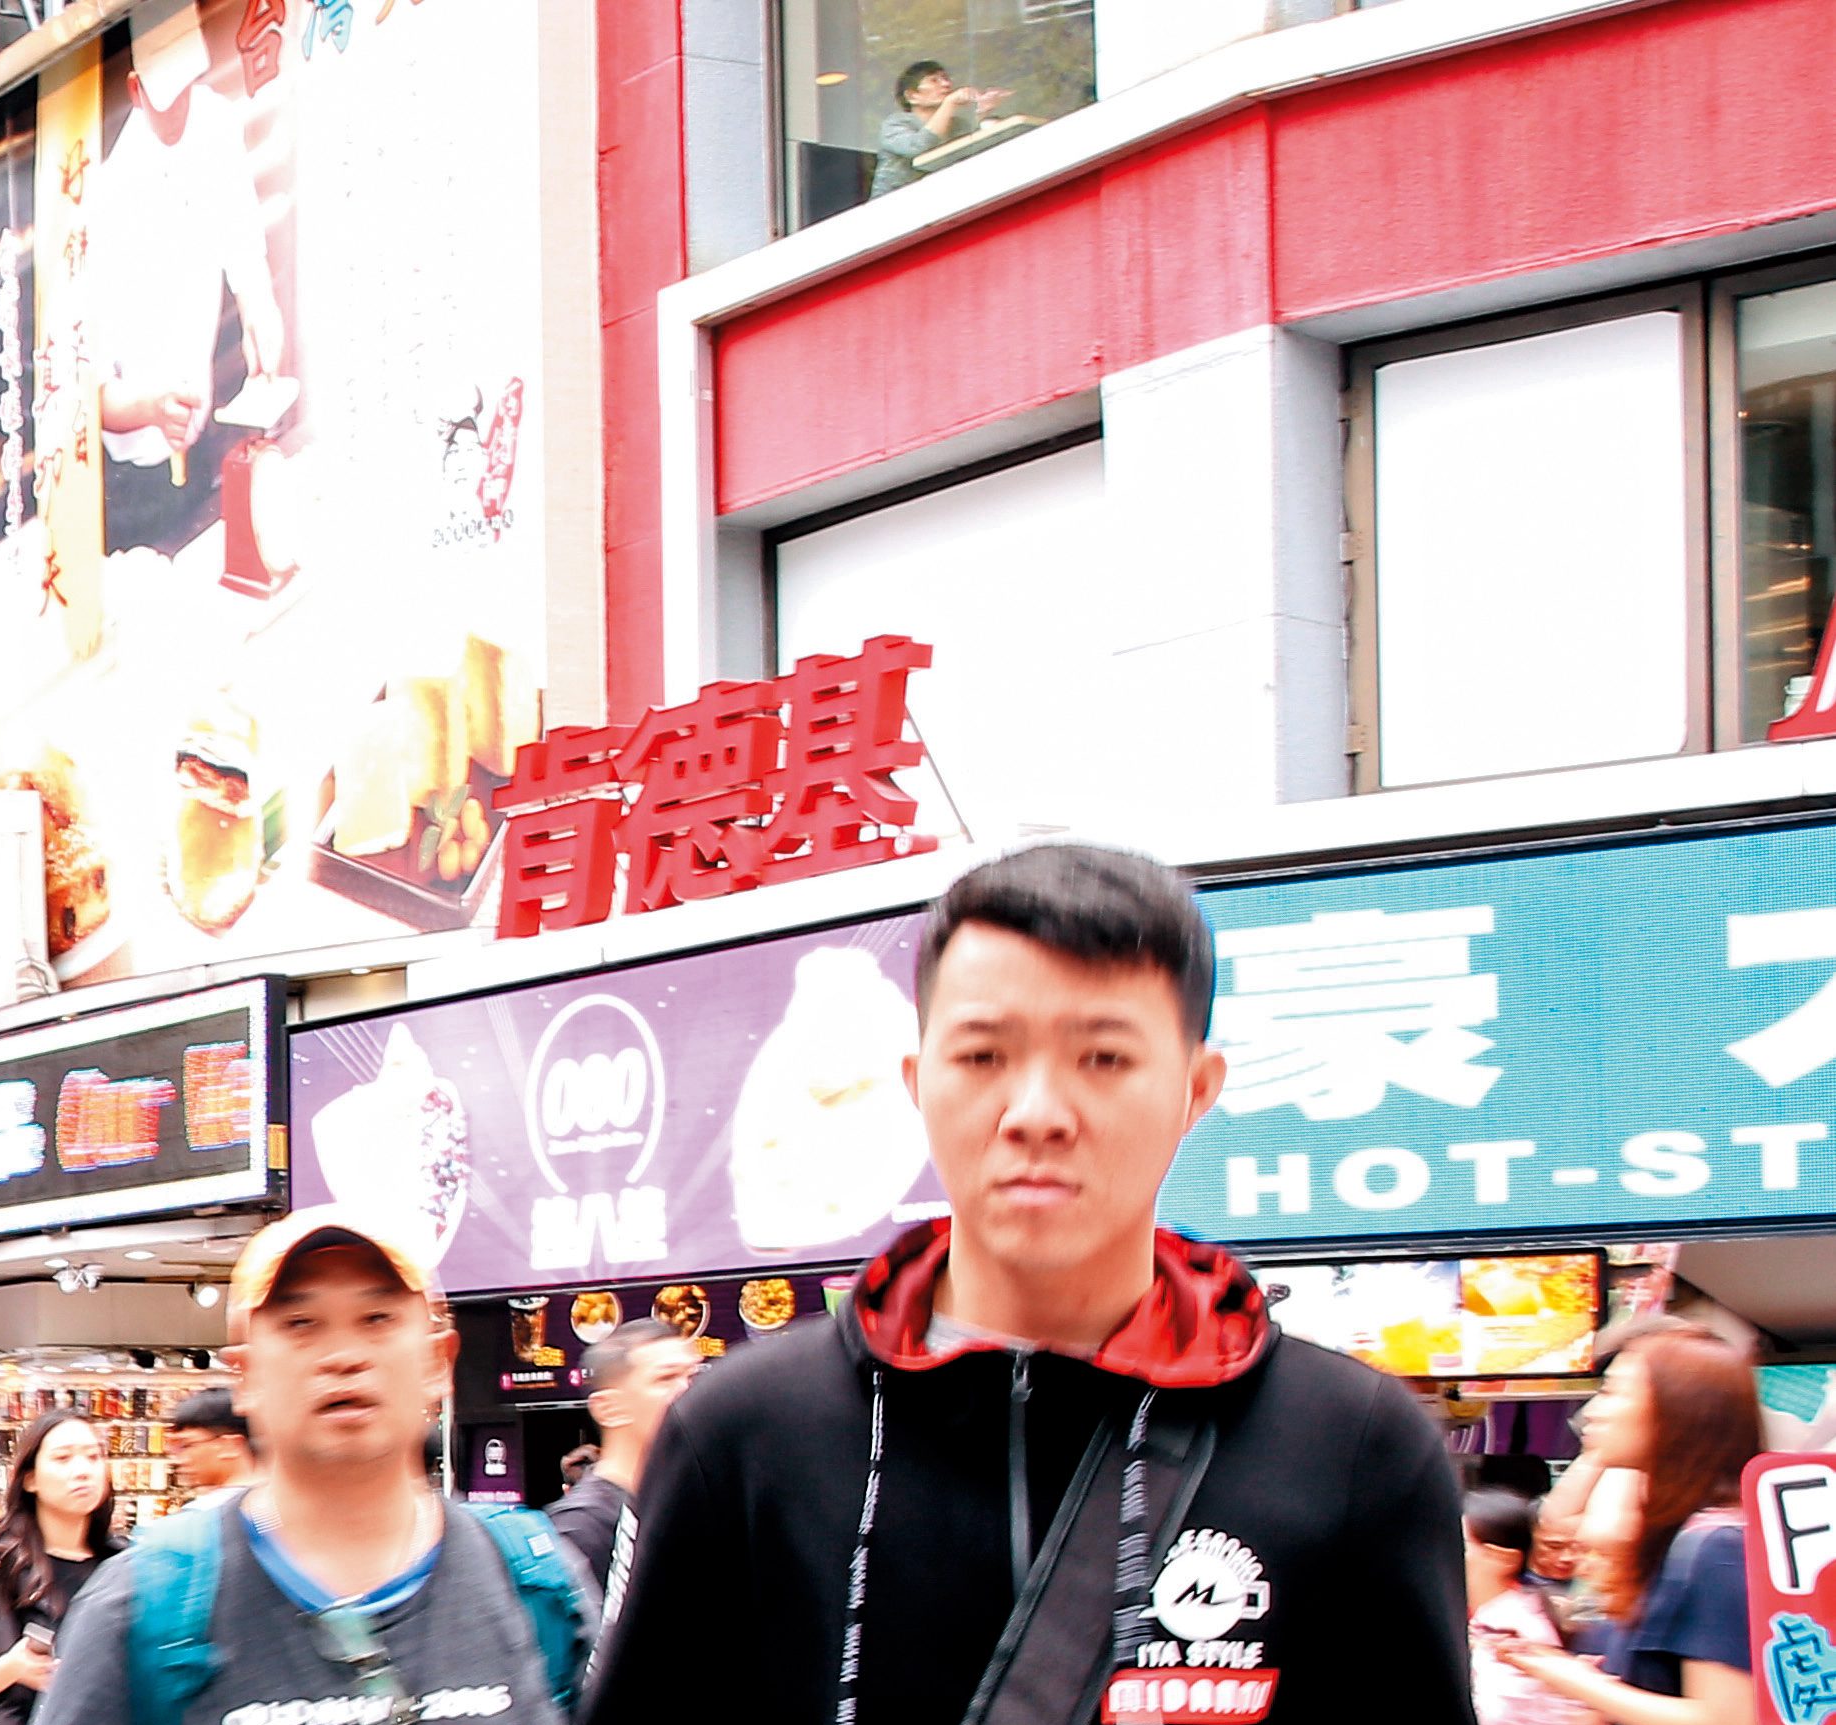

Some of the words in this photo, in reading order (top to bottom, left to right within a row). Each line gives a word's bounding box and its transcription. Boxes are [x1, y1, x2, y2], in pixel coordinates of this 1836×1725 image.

[492, 634, 934, 941] 肯德基
[1226, 1121, 1828, 1218] HOT-ST
[1185, 1640, 1264, 1670] STYLE
